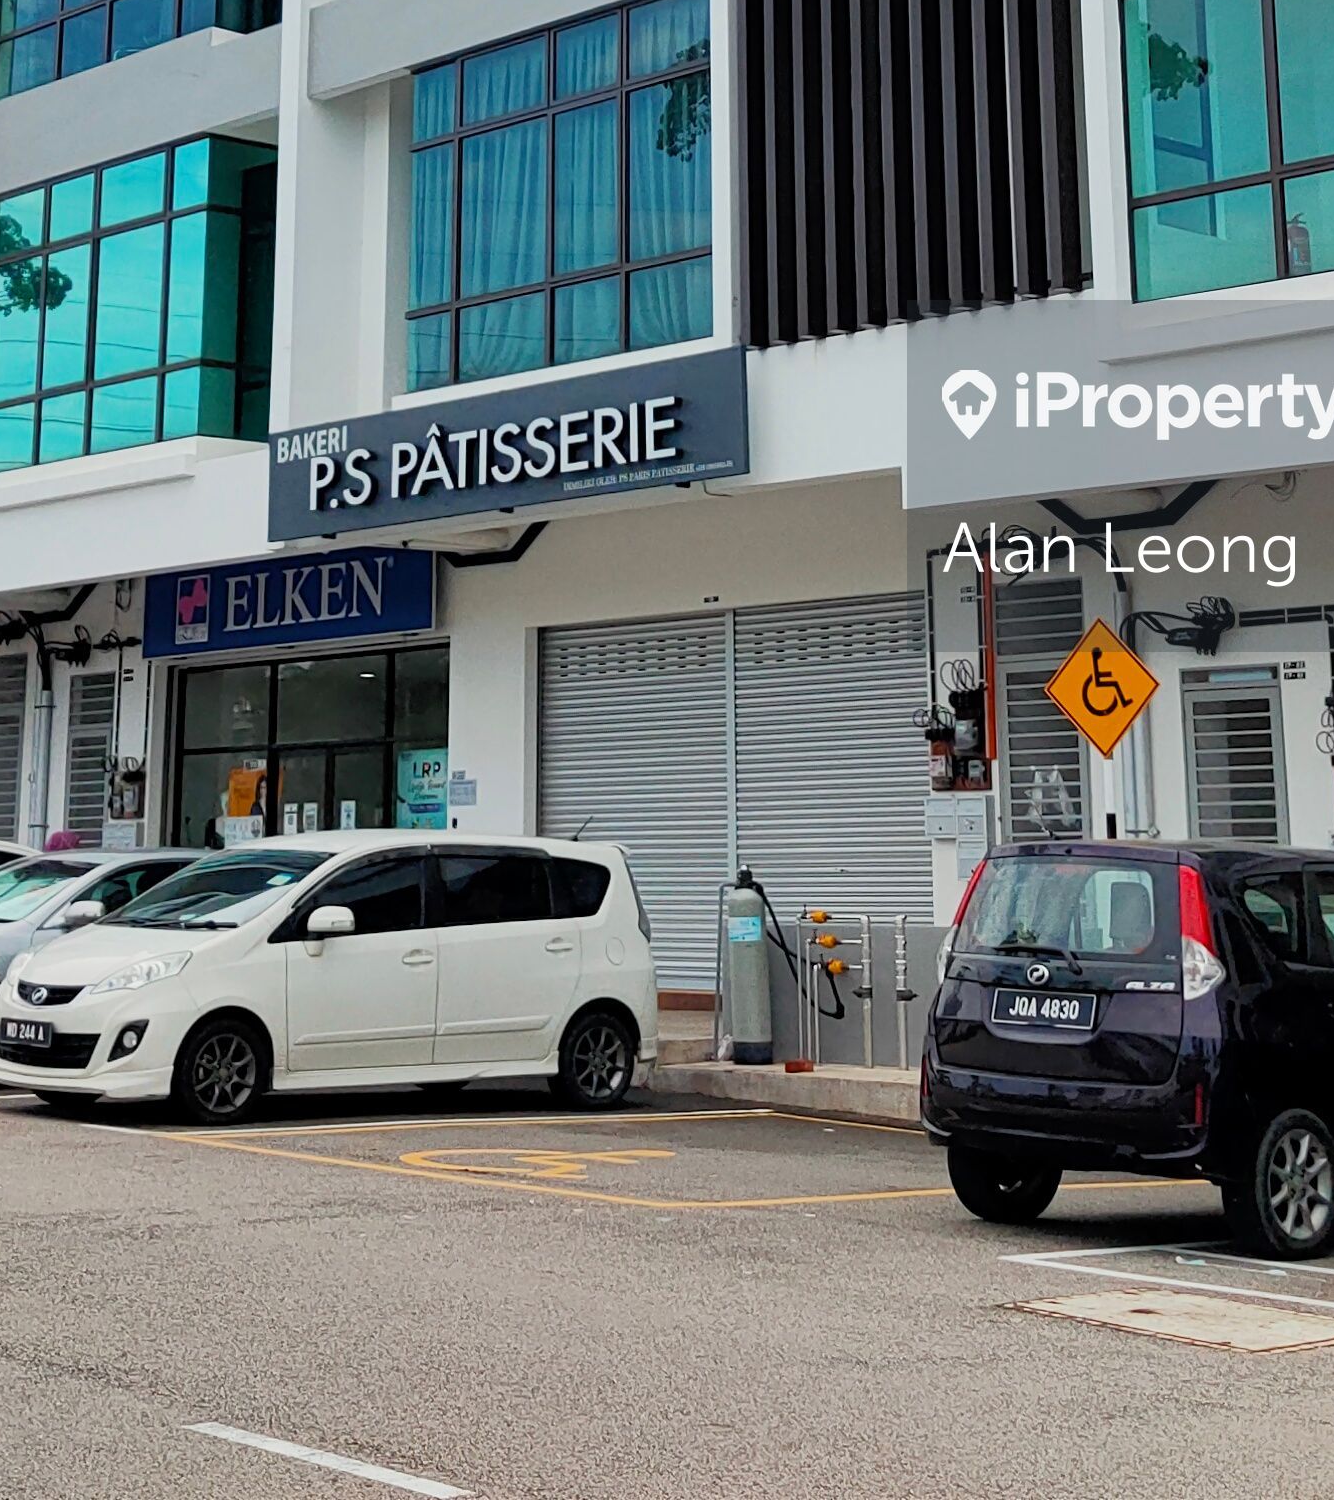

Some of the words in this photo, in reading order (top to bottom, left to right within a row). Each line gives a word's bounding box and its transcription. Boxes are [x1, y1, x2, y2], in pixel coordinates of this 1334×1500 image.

[276, 424, 348, 464] BAKERI
[308, 448, 373, 511] P.S
[390, 395, 677, 499] PÂTISSERIE
[223, 556, 387, 632] ELKEN
[413, 761, 441, 779] LRP
[1125, 981, 1176, 991] ALZA
[1008, 995, 1037, 1018] JQA
[1040, 997, 1080, 1020] 4830
[19, 1023, 36, 1040] 244
[37, 1025, 45, 1041] A
